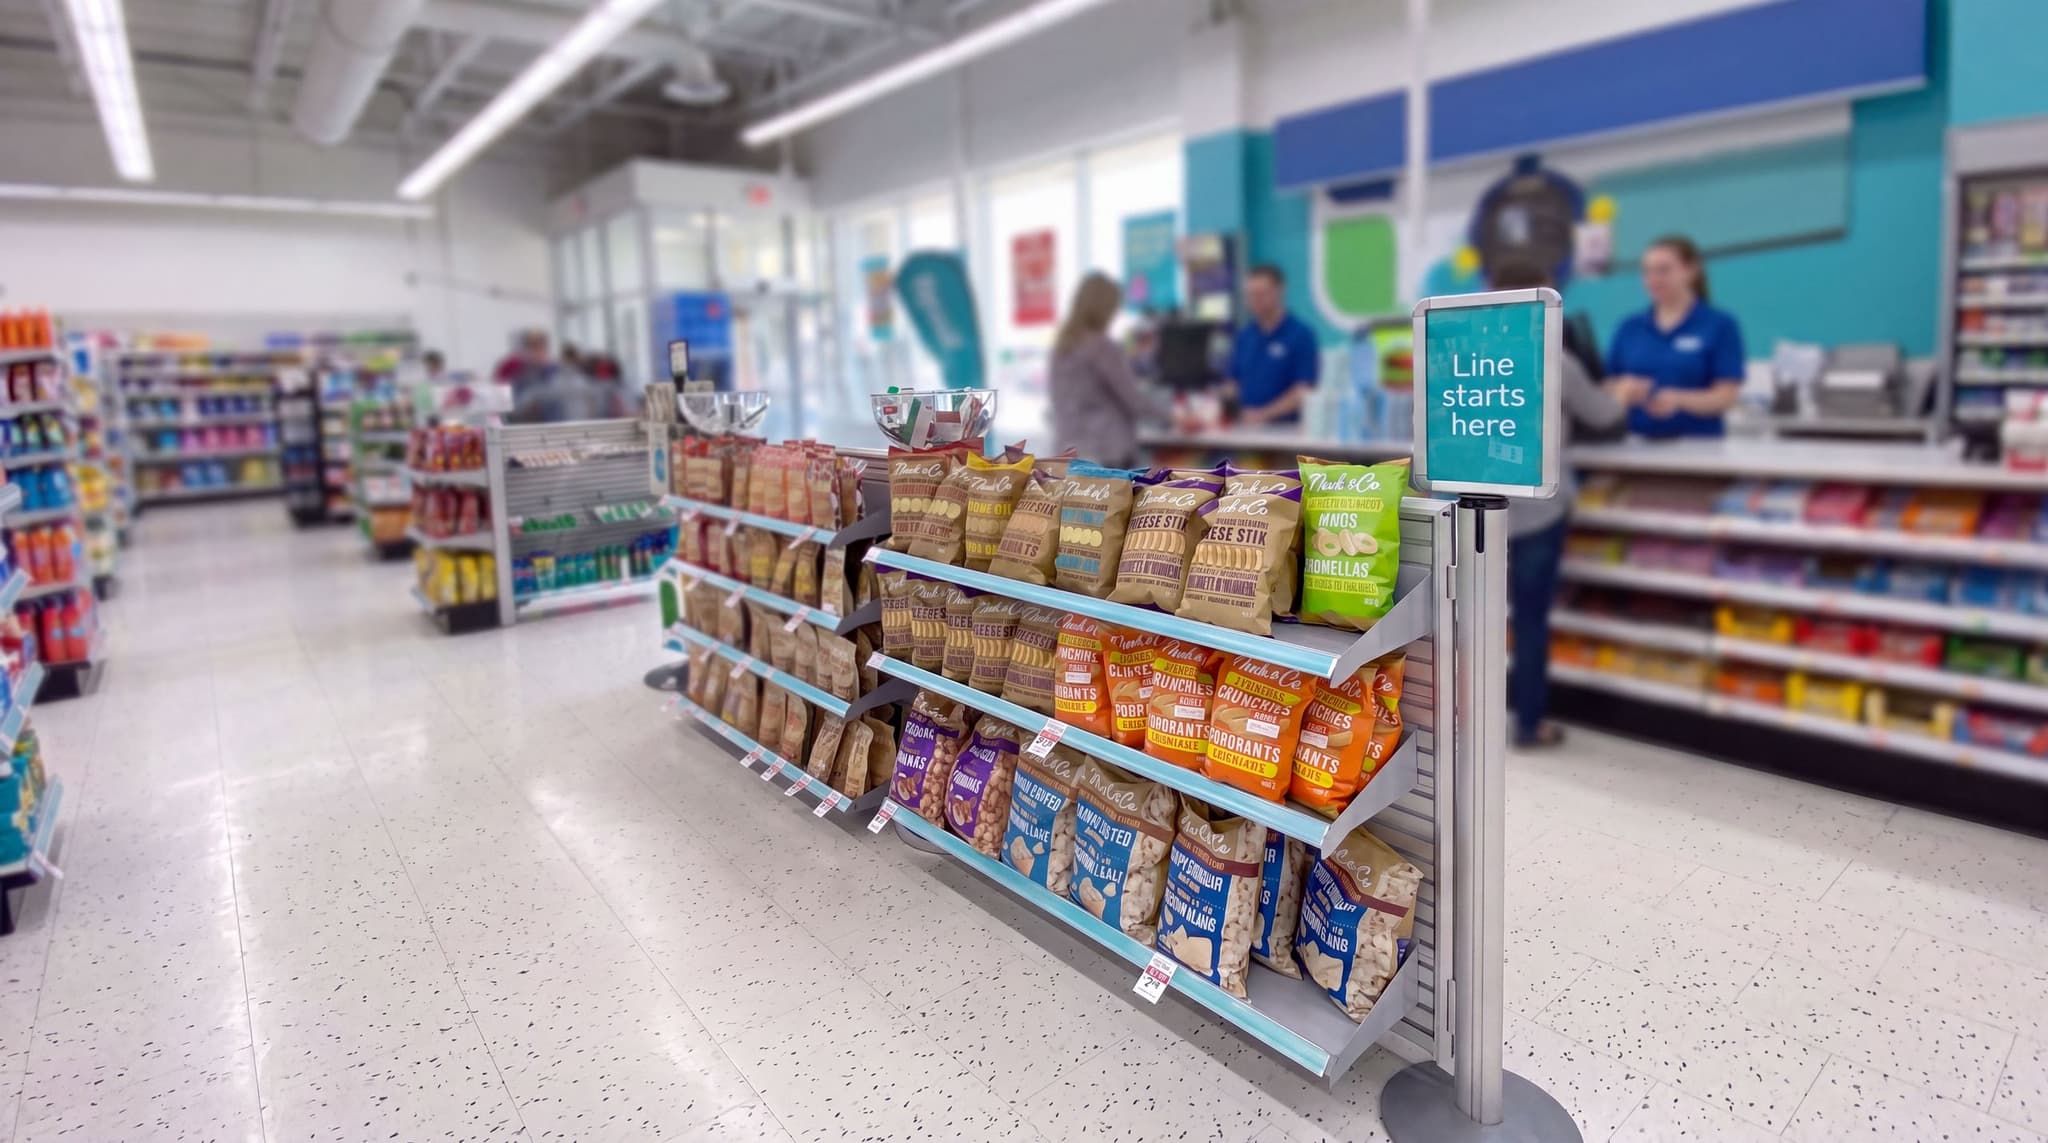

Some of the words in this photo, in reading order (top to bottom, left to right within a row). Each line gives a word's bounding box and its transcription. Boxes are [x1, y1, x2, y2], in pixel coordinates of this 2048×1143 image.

[1453, 352, 1514, 377] Line
[1442, 383, 1526, 408] starts
[1452, 411, 1516, 437] here
[1318, 512, 1358, 529] MNOS
